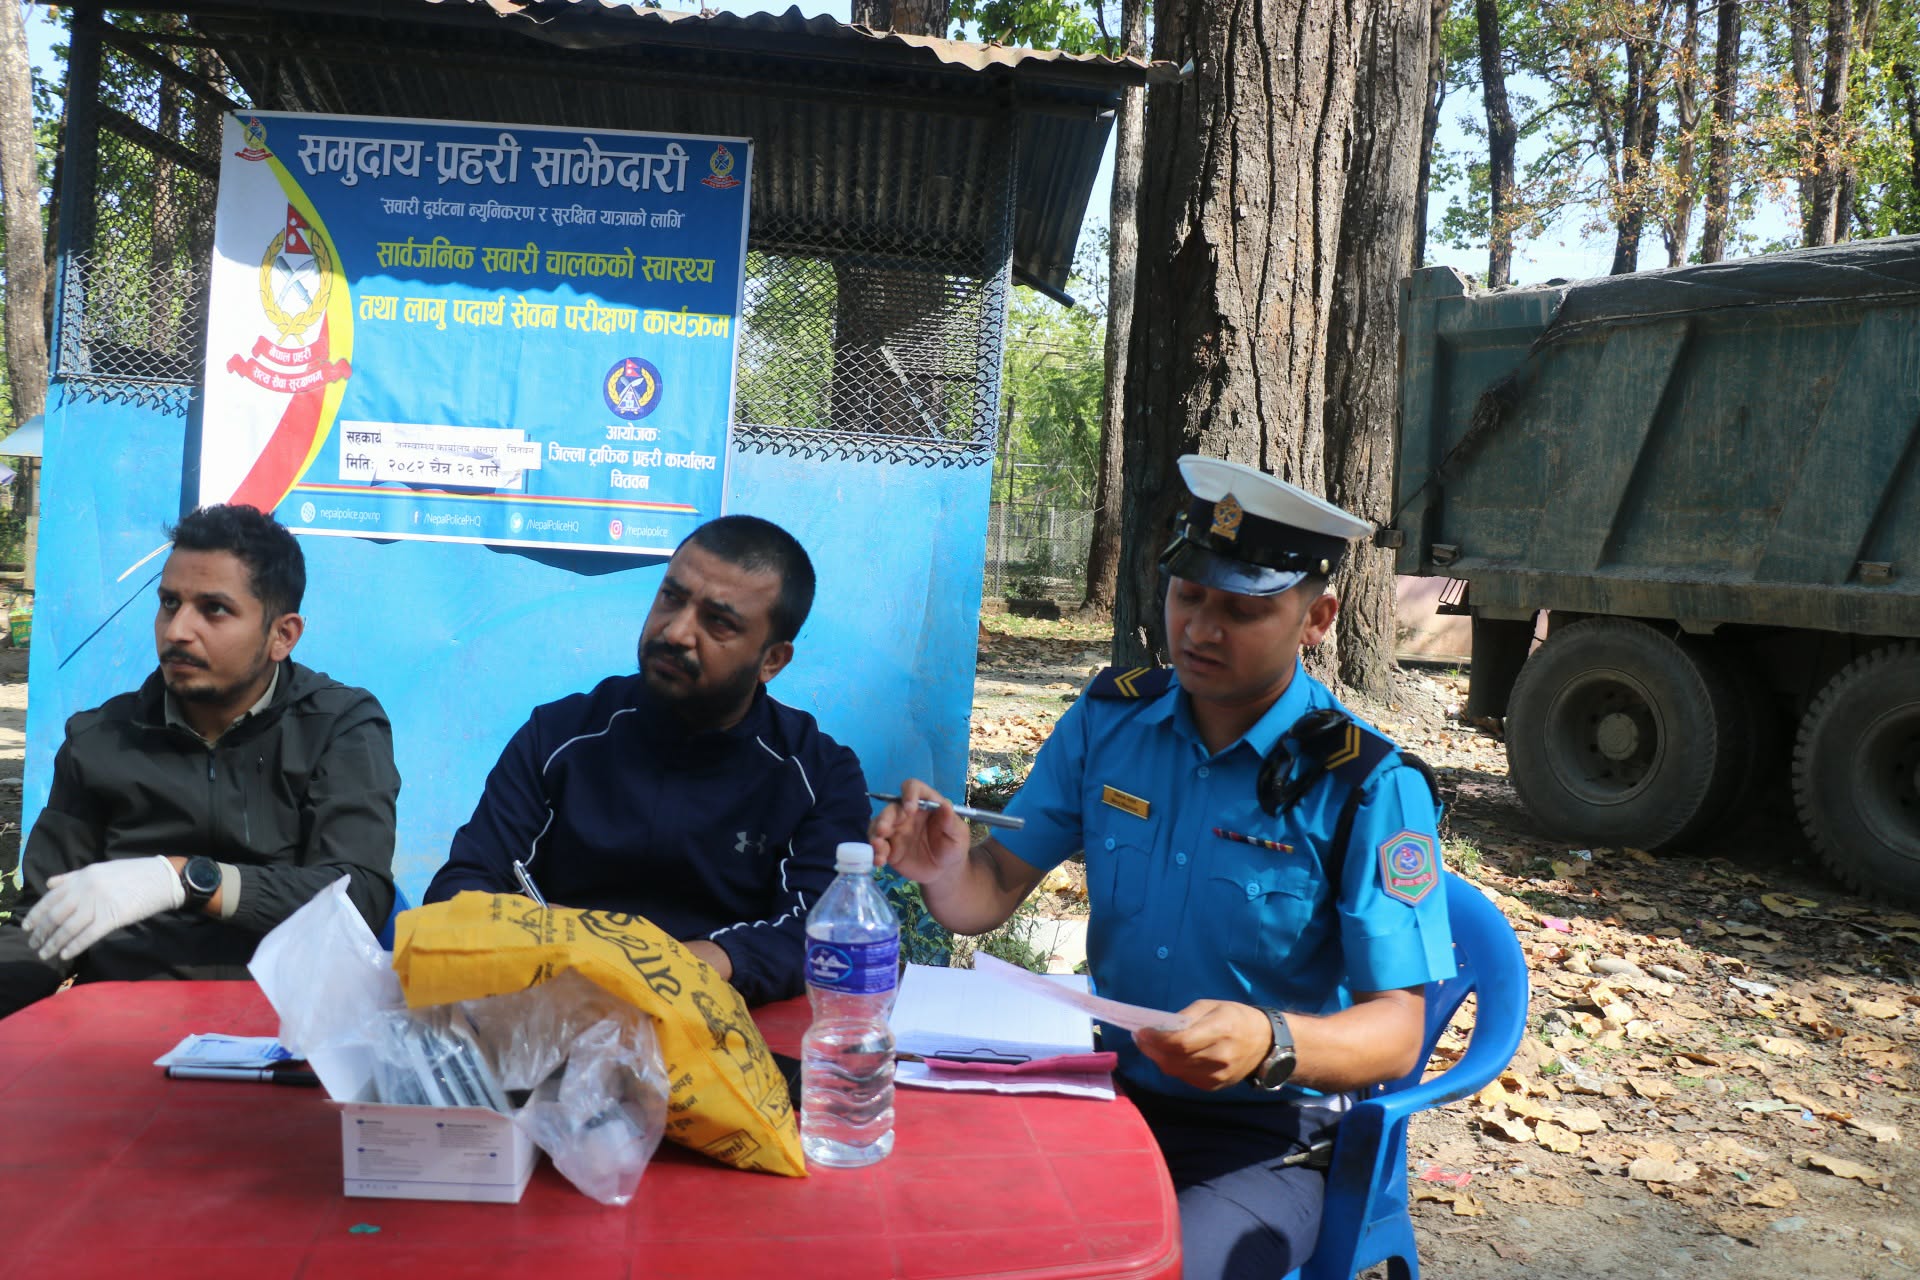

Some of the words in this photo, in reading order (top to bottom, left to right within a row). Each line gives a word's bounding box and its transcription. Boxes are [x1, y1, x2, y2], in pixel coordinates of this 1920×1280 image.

[298, 133, 522, 186] समुदाय-प्रहरी
[532, 137, 690, 193] साझेदारी
[423, 198, 466, 220] दुर्घटना
[469, 200, 536, 222] न्युनिकरण
[538, 207, 549, 222] र
[552, 204, 597, 226] सुरक्षित
[601, 208, 647, 227] यात्राको
[376, 236, 477, 270] सार्वजनिक
[482, 242, 540, 275] सवारी
[546, 247, 636, 279] चालकको
[641, 256, 716, 284] स्वास्थ्य
[359, 295, 399, 321] तथा
[403, 297, 448, 330] लागु
[452, 295, 506, 327] पदार्थ
[510, 295, 559, 329] सेवन
[564, 299, 638, 335] परीक्षण
[642, 306, 731, 338] कार्यक्रम
[388, 459, 425, 473] २०८२
[430, 457, 451, 475] चैत्र
[458, 464, 474, 478] २६
[479, 460, 500, 477] गते
[548, 442, 587, 463] जिल्ला
[588, 443, 630, 467] ट्राफिक
[632, 448, 662, 467] प्रहरी
[664, 451, 717, 470] कार्यालय
[610, 468, 651, 490] चितवन
